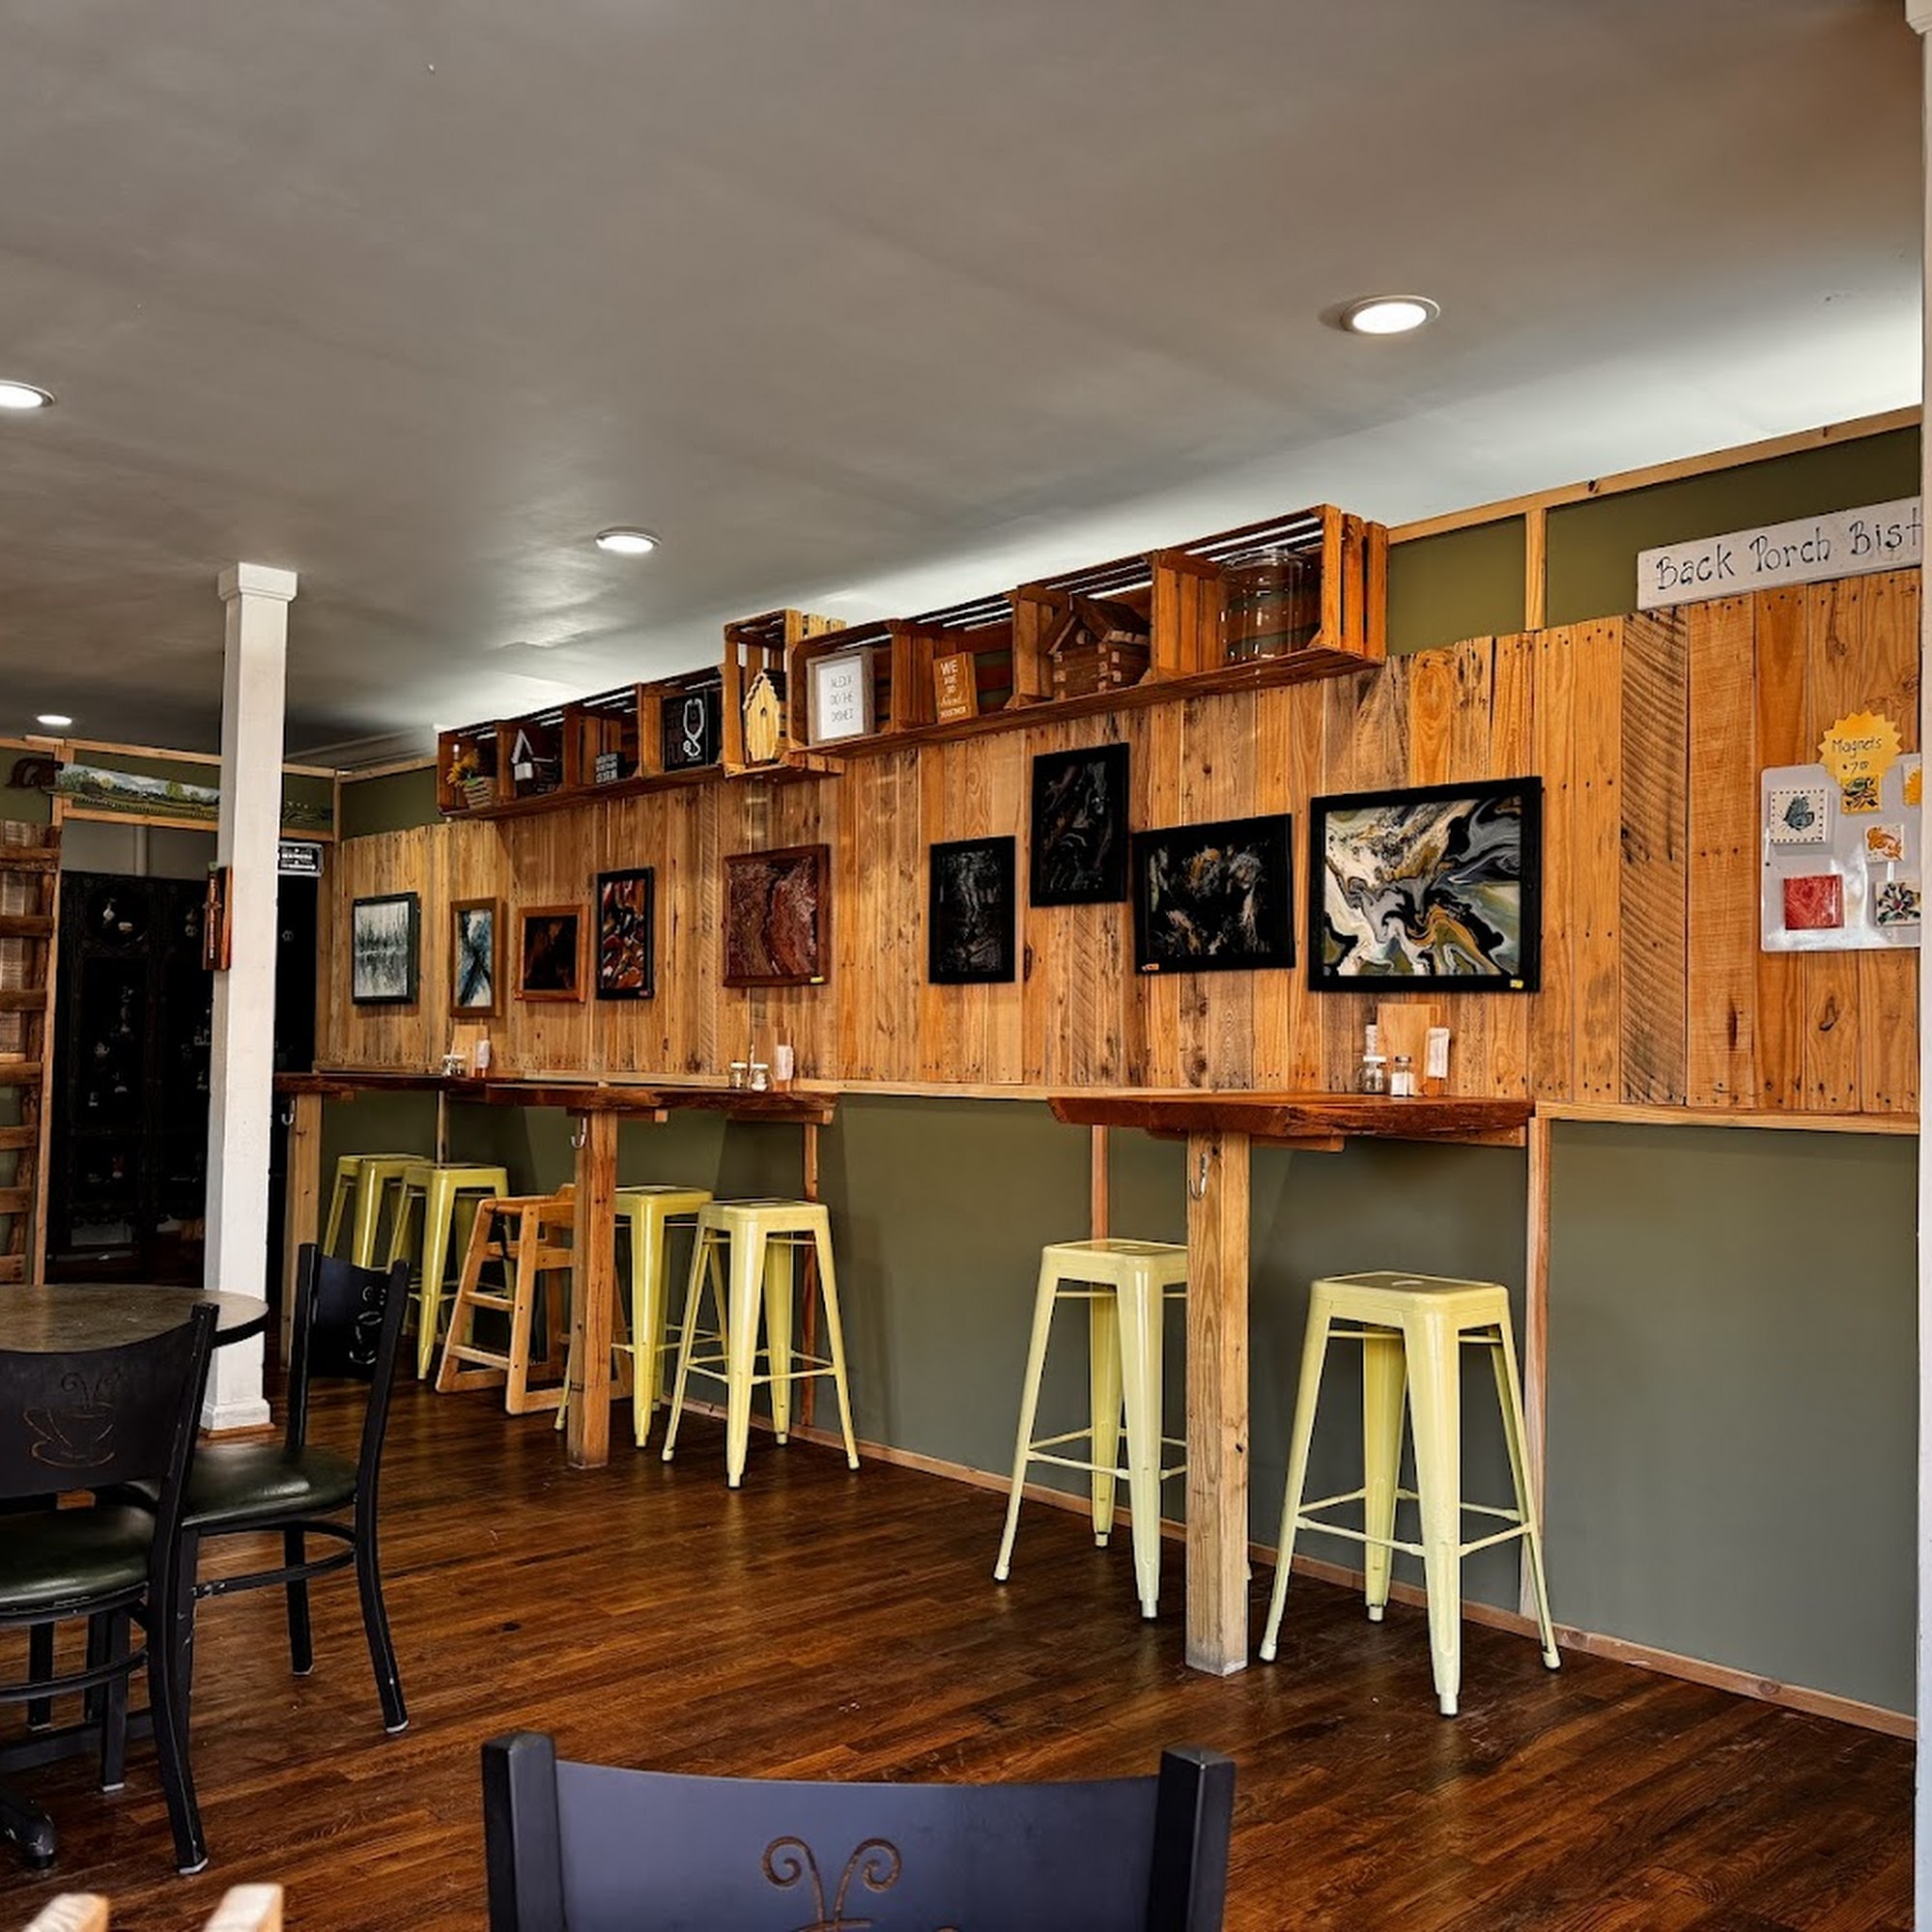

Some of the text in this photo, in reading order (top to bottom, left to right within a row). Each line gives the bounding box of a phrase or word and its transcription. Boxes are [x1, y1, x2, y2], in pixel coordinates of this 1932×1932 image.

[1656, 543, 1736, 590] Back
[1749, 527, 1831, 572] Porch
[940, 659, 958, 675] WE
[1832, 737, 1882, 759] Magnets
